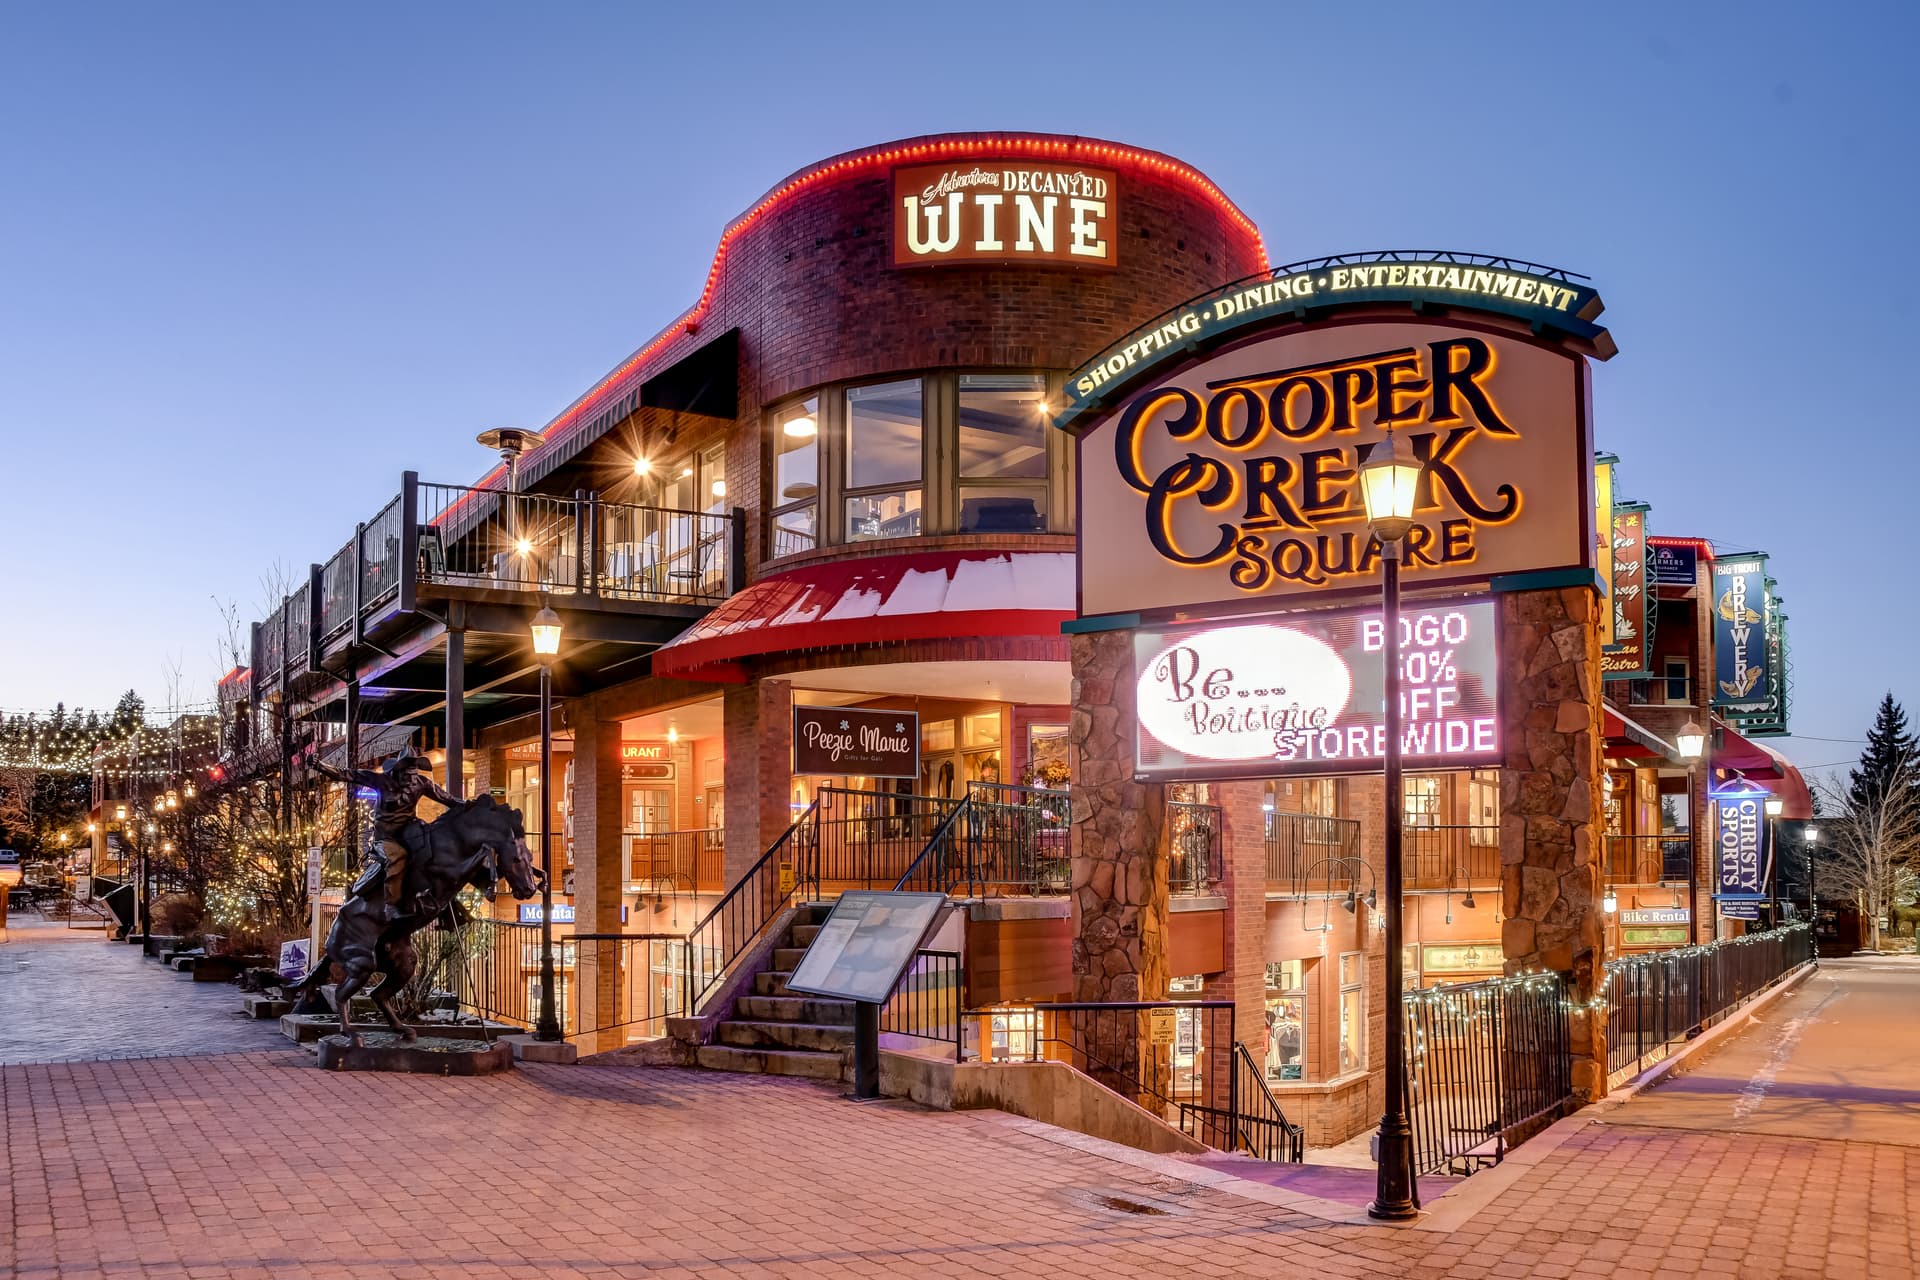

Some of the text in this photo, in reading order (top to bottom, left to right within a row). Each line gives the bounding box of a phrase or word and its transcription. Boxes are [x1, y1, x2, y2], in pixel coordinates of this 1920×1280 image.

[903, 191, 1107, 259] WINE
[1076, 264, 1579, 398] SHOPPING DINING ENTERTAINMENT
[1114, 336, 1519, 495] COOPER
[1146, 425, 1520, 566] CREK
[1229, 517, 1476, 590] SQUARE
[1717, 561, 1761, 577] BIG TROUT
[1398, 649, 1458, 684] 0%
[1600, 656, 1640, 671] Bistro
[1730, 575, 1751, 698] BREWERY
[803, 720, 911, 762] Peezie Marie
[1184, 700, 1328, 735] Boutique
[1721, 806, 1740, 887] SPORTS
[1739, 800, 1758, 893] CHRISTY
[525, 906, 576, 921] Montai
[1622, 910, 1690, 923] Bike Rental
